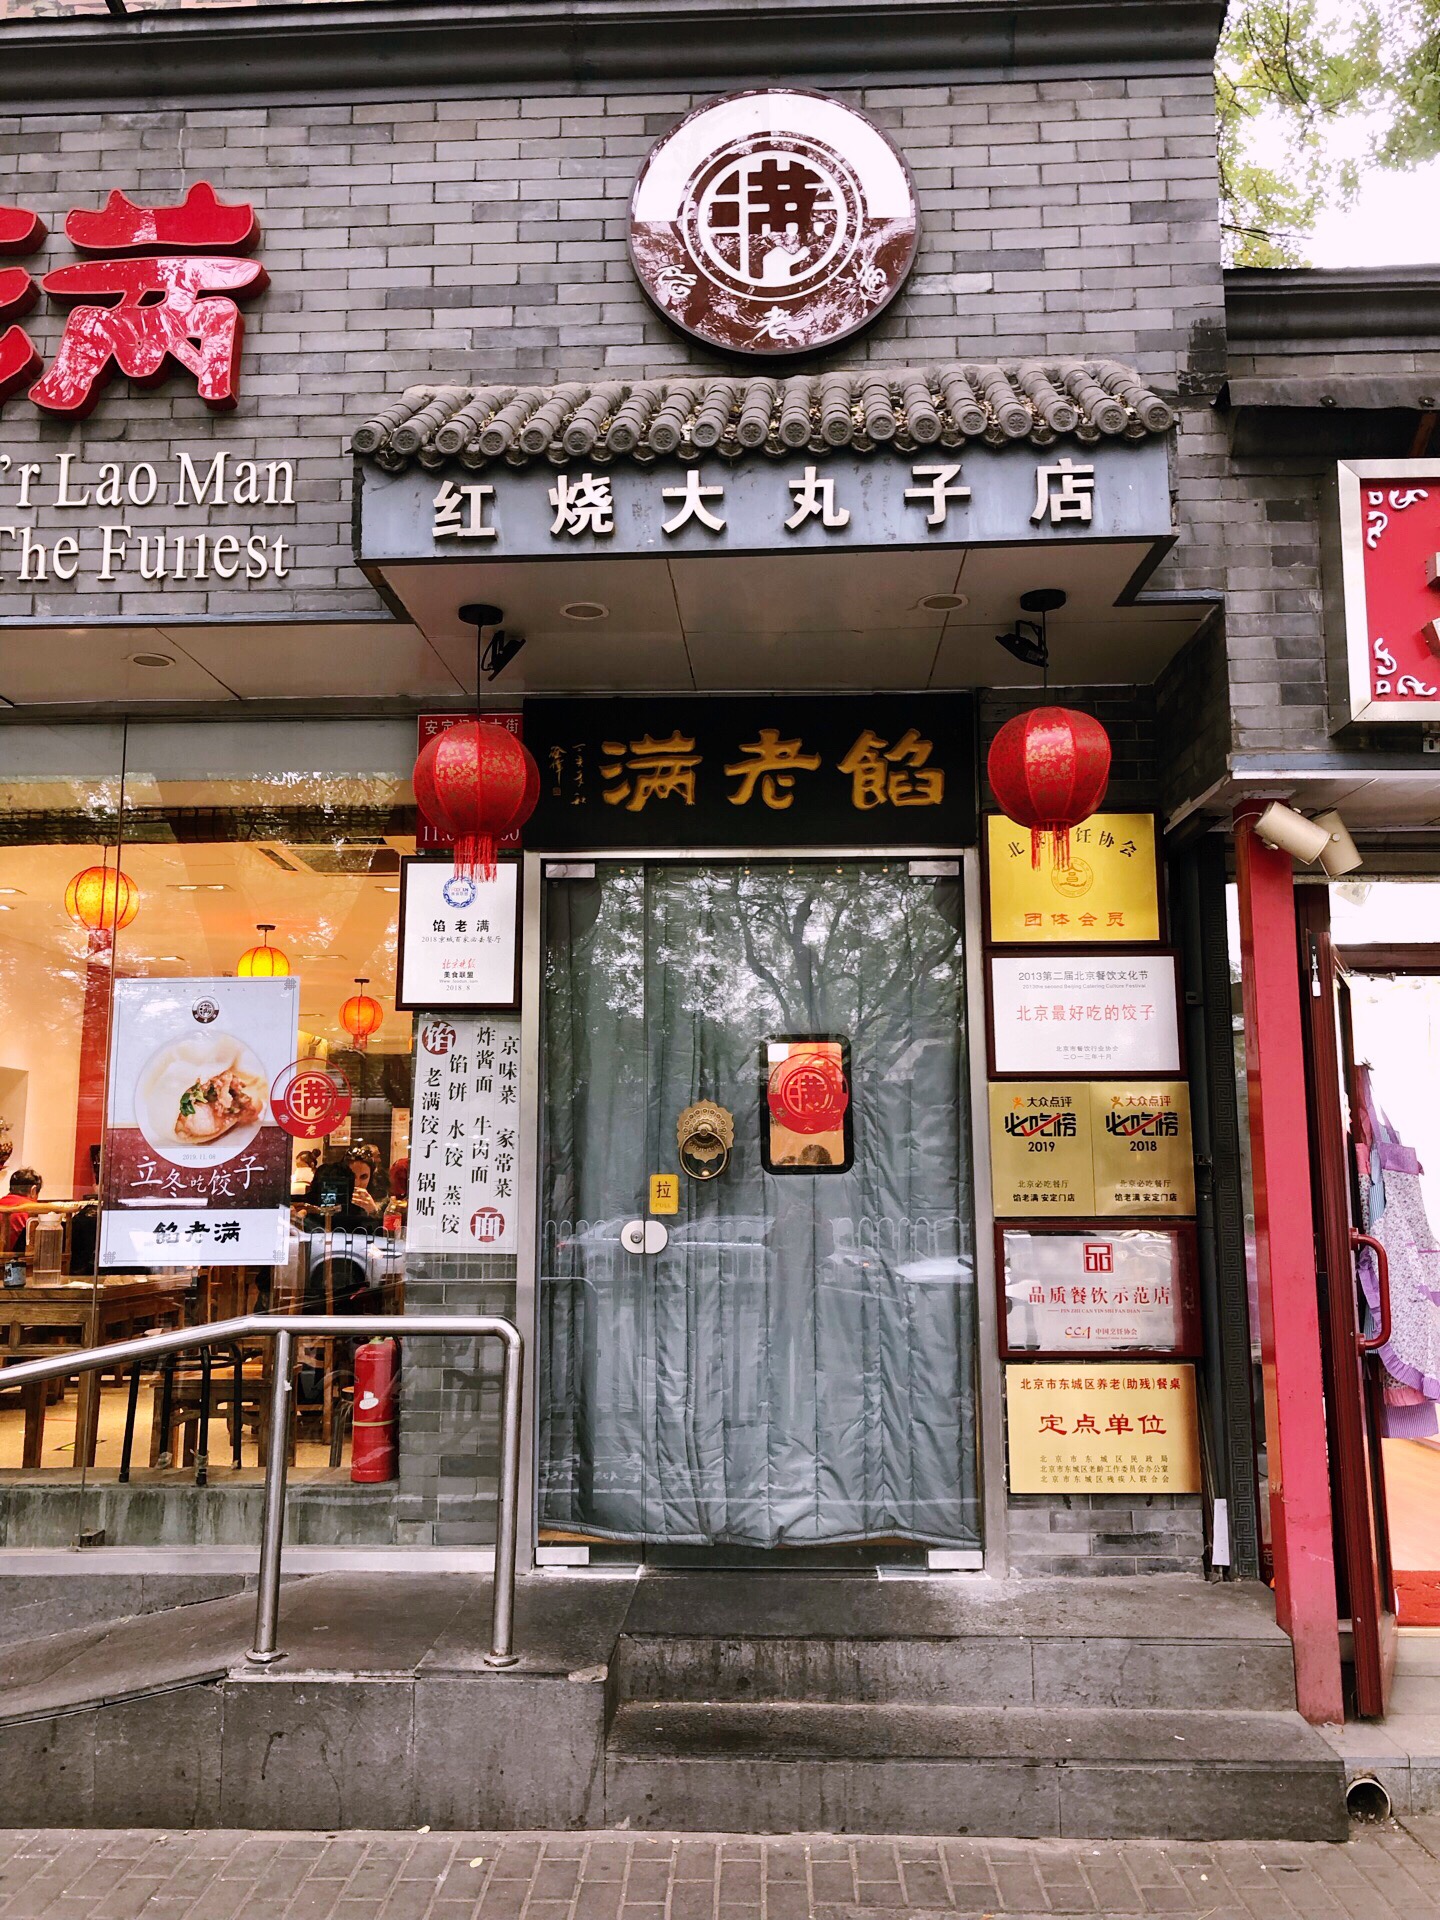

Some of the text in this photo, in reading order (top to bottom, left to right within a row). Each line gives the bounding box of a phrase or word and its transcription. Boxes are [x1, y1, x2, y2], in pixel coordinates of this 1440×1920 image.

[52, 453, 159, 508] Lao
[173, 451, 296, 508] Man
[432, 457, 1096, 541] 红烧大丸子店
[425, 718, 519, 735] 安定街
[432, 919, 490, 933] 馅老满
[1024, 911, 1126, 927] 团体会员
[443, 971, 475, 979] 美食联盟
[1018, 970, 1149, 981] 2013第二届北京餐饮文化节
[1016, 1004, 1155, 1022] 北京最好吃的饺子
[421, 1021, 457, 1055] 馅
[470, 1026, 497, 1185] 炸酱面 牛肉面
[1027, 1096, 1073, 1108] 大众点评
[1125, 1095, 1172, 1108] 大众点评
[493, 1035, 520, 1199] 京味菜 家常菜
[1004, 1112, 1077, 1137] 必吃榜
[1105, 1111, 1179, 1137] 必吃榜
[415, 1067, 444, 1217] 老满饺子 锅贴
[440, 1053, 468, 1235] 馅饼 水饺 蒸饺
[1028, 1141, 1056, 1152] 2019
[1129, 1140, 1158, 1152] 2018
[130, 1155, 265, 1198] 立冬吃饺子
[1017, 1179, 1070, 1189] 北京必吃餐厅
[1119, 1179, 1172, 1189] 北京必吃餐厅
[656, 1180, 672, 1199] 拉
[1012, 1193, 1076, 1202] 馅老满 安定门店
[1114, 1193, 1177, 1202] 馅老满 安定门店
[470, 1207, 505, 1243] 面
[1028, 1285, 1172, 1305] 品质餐饮示范店
[1095, 1327, 1138, 1336] 中国烹饪协会
[1020, 1377, 1181, 1391] 北京市东城区养老(助残)餐桌
[1038, 1413, 1168, 1436] 定点单位
[1039, 1454, 1169, 1463] 北京市东城区民政局
[1040, 1464, 1169, 1474] 北京市东城区老龄工作委员会办公室
[1040, 1474, 1170, 1484] 北京市东城区残疾人联合会
